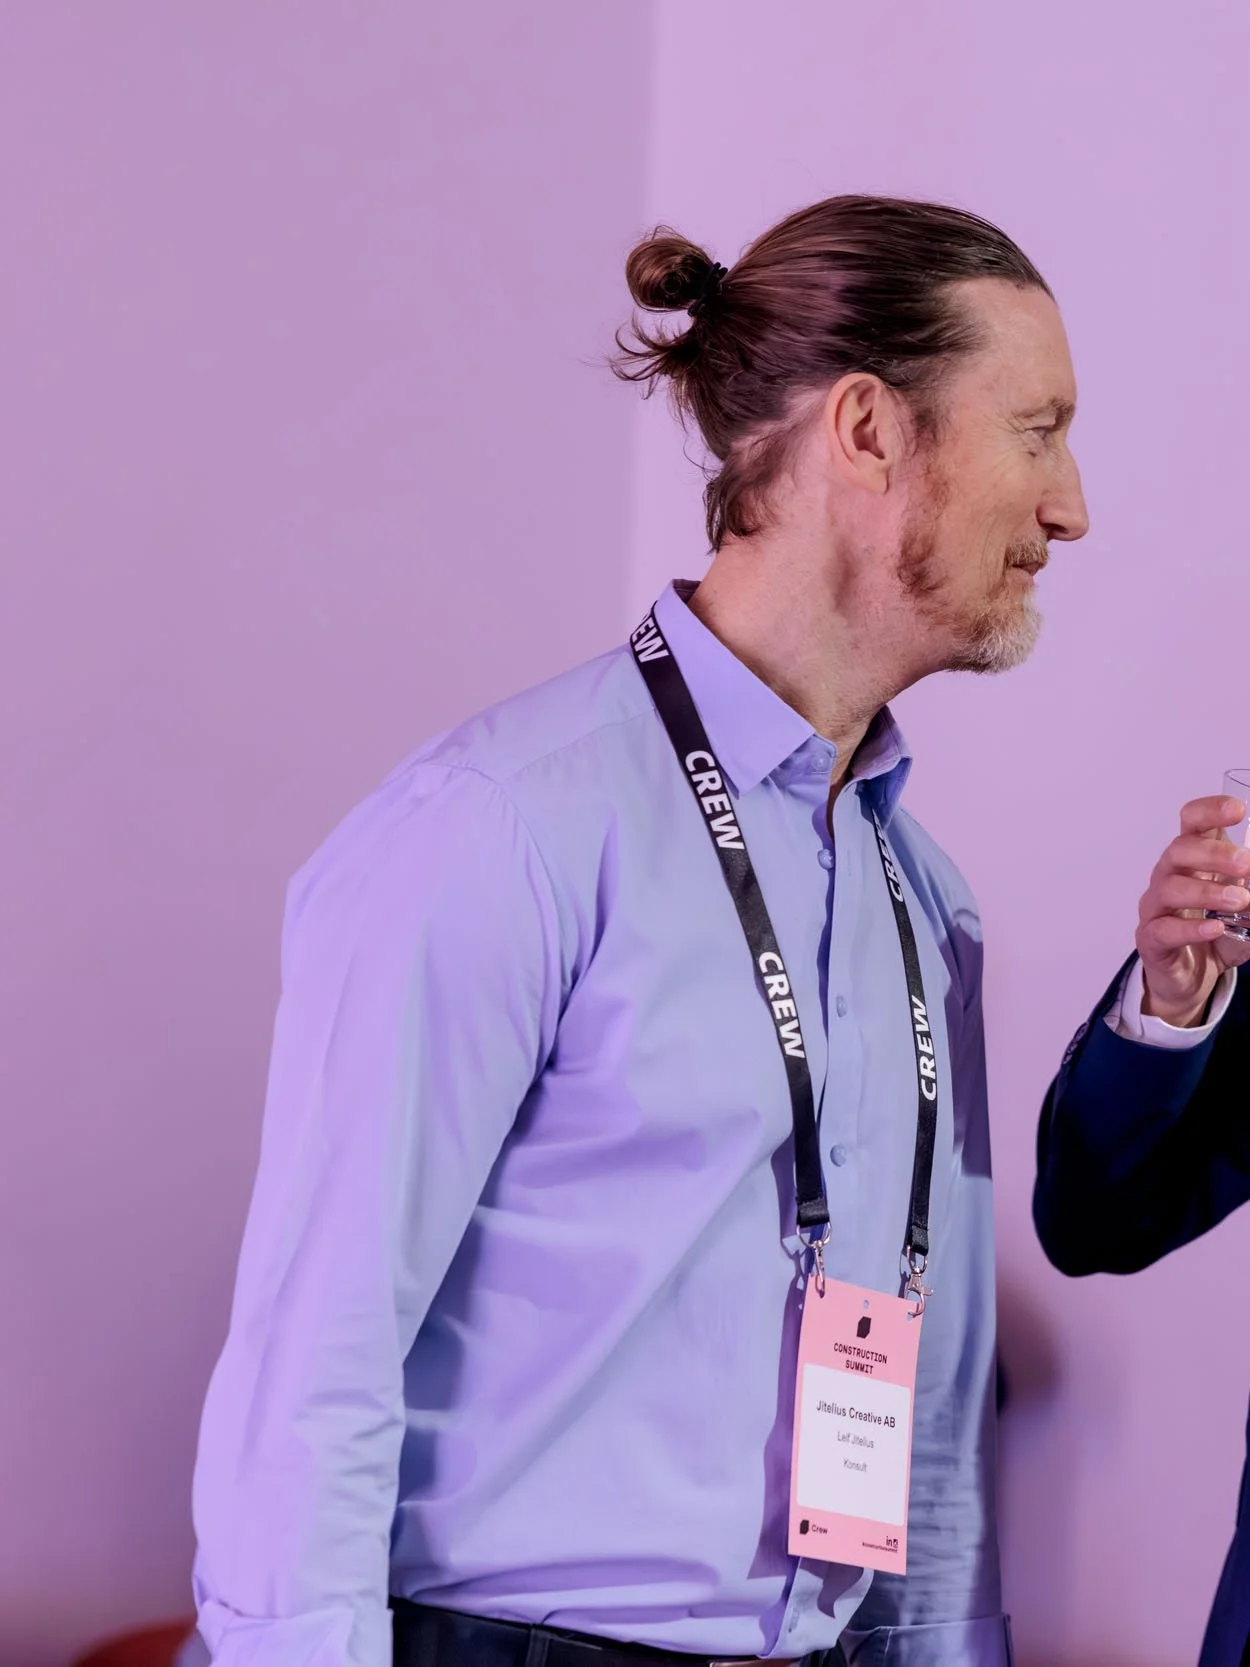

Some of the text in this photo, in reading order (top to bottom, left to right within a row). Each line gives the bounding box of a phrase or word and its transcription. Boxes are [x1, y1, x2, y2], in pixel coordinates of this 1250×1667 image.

[631, 613, 671, 663] EW
[684, 750, 745, 850] CREW
[758, 951, 805, 1059] CREW
[911, 994, 937, 1101] CREW
[833, 1342, 888, 1364] CONSTRUCTION
[845, 1359, 874, 1374] SUMMIT
[816, 1400, 896, 1428] Jitelius Creative AB
[811, 1524, 828, 1535] Crew
